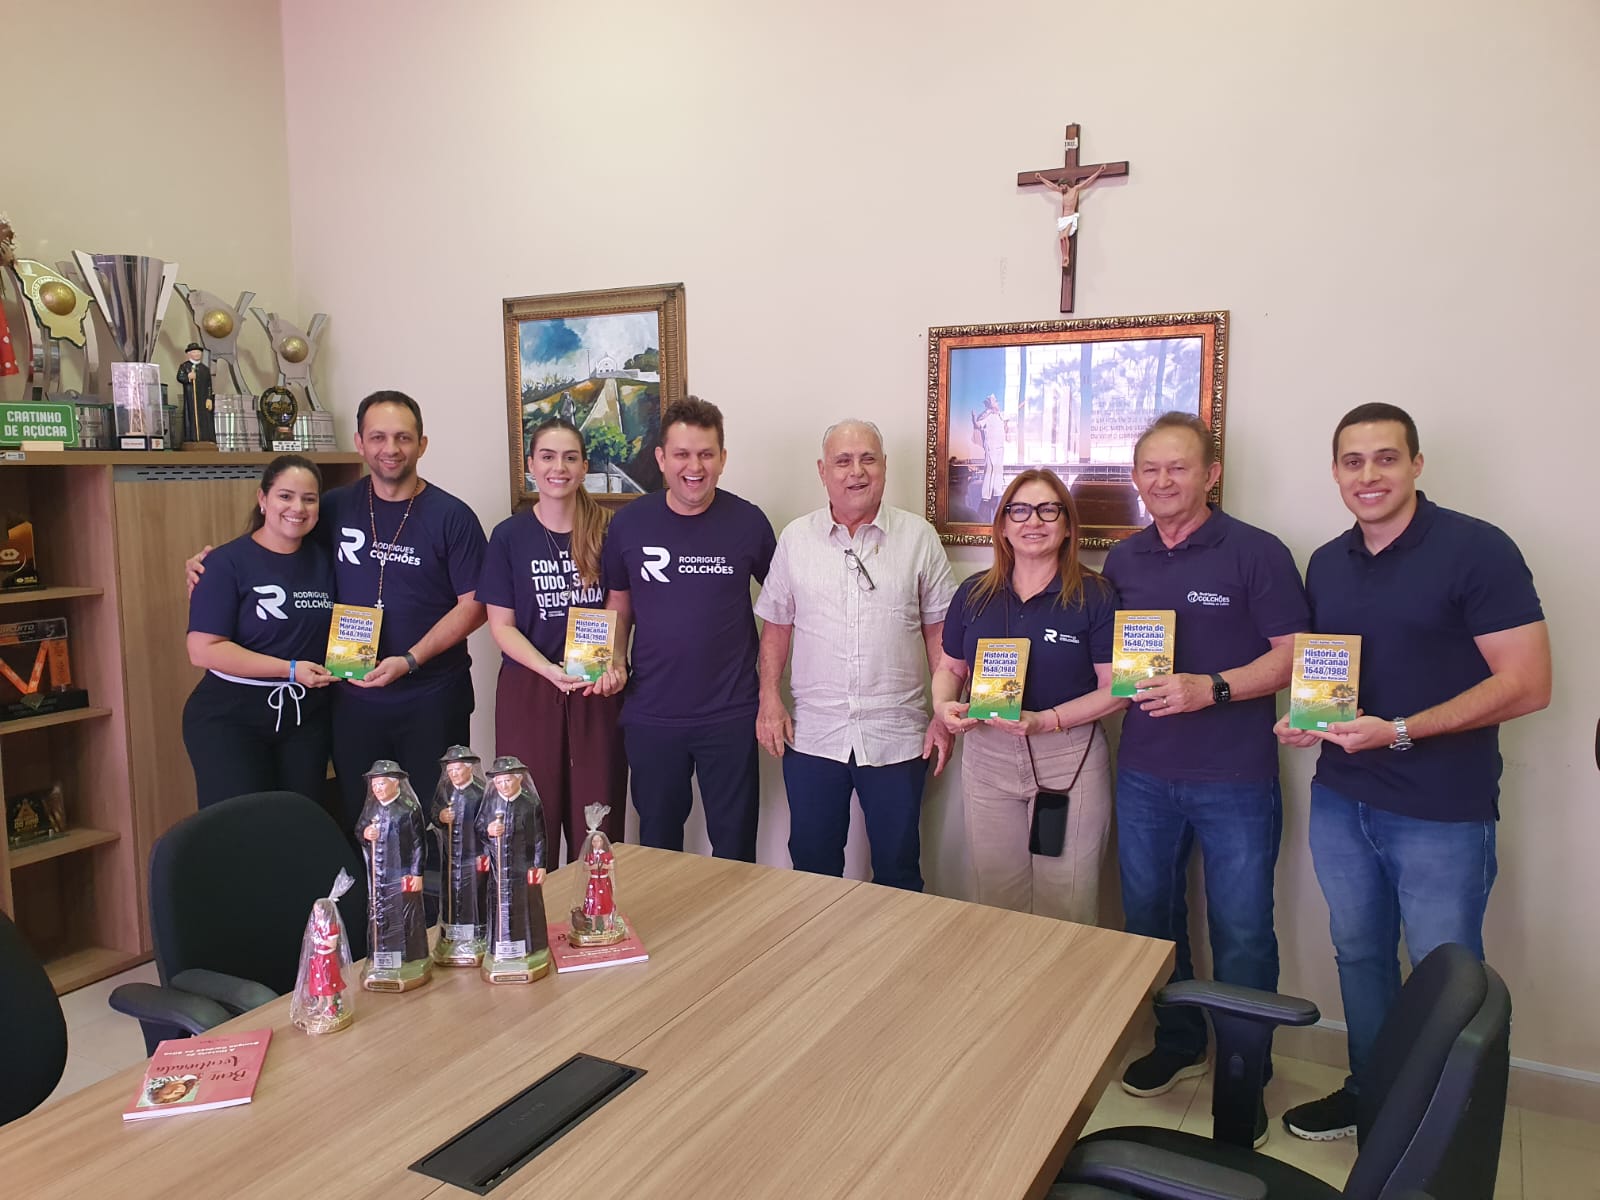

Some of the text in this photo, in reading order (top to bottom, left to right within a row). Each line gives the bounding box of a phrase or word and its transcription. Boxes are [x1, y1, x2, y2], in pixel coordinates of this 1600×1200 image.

[7, 411, 62, 423] CRATINHO
[4, 424, 67, 439] DE AÇÚCAR
[338, 527, 366, 565] R
[372, 541, 415, 555] RODRIGUES
[370, 550, 421, 566] COLCHÕES
[641, 547, 671, 582] R
[678, 556, 726, 564] RODRIGUES
[531, 560, 559, 574] COM
[678, 564, 734, 574] COLCHÕES
[532, 575, 570, 591] TUDO,
[252, 584, 289, 620] R
[293, 591, 329, 599] RODRIGUES
[536, 592, 568, 607] DEUS
[294, 598, 334, 609] COLCHÕE
[1305, 649, 1348, 658] História de
[1305, 667, 1347, 676] 1648/1988
